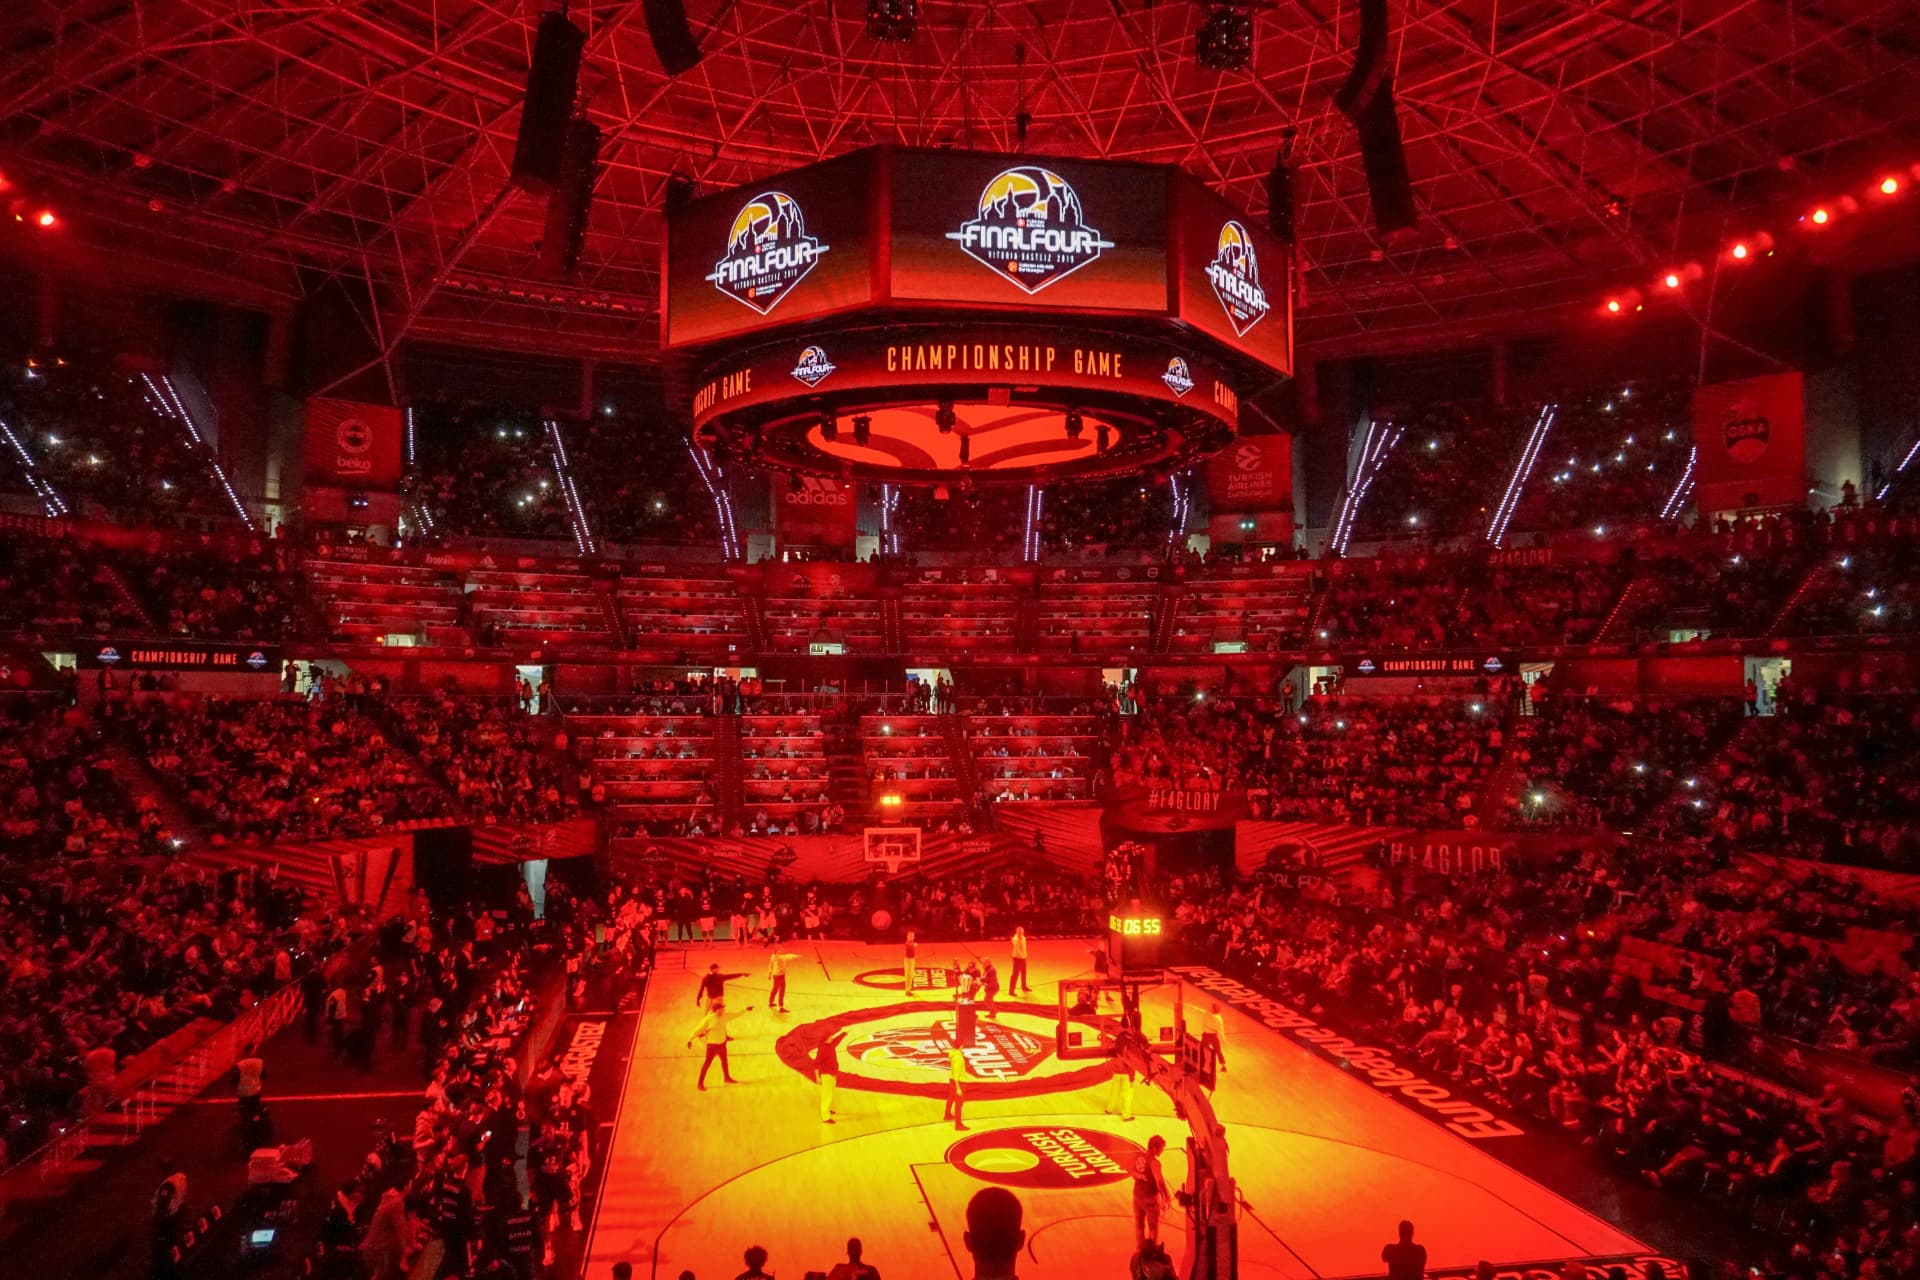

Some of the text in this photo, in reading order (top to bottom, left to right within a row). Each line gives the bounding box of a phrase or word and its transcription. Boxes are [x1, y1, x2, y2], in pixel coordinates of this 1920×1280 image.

[886, 344, 1123, 378] CHAMPIONSHIP GAME
[722, 368, 752, 400] GAME
[337, 455, 372, 470] beko
[785, 490, 848, 505] adidas
[130, 649, 238, 666] CHAMPIONSHIP GAME
[1383, 658, 1476, 672] CHAMPIONSHIP GAME
[1148, 788, 1219, 812] #F4GLORY
[1168, 966, 1525, 1139] Euroleague Basketball
[1022, 1132, 1097, 1180] TURKISH
[1050, 1128, 1129, 1175] AIRLINES
